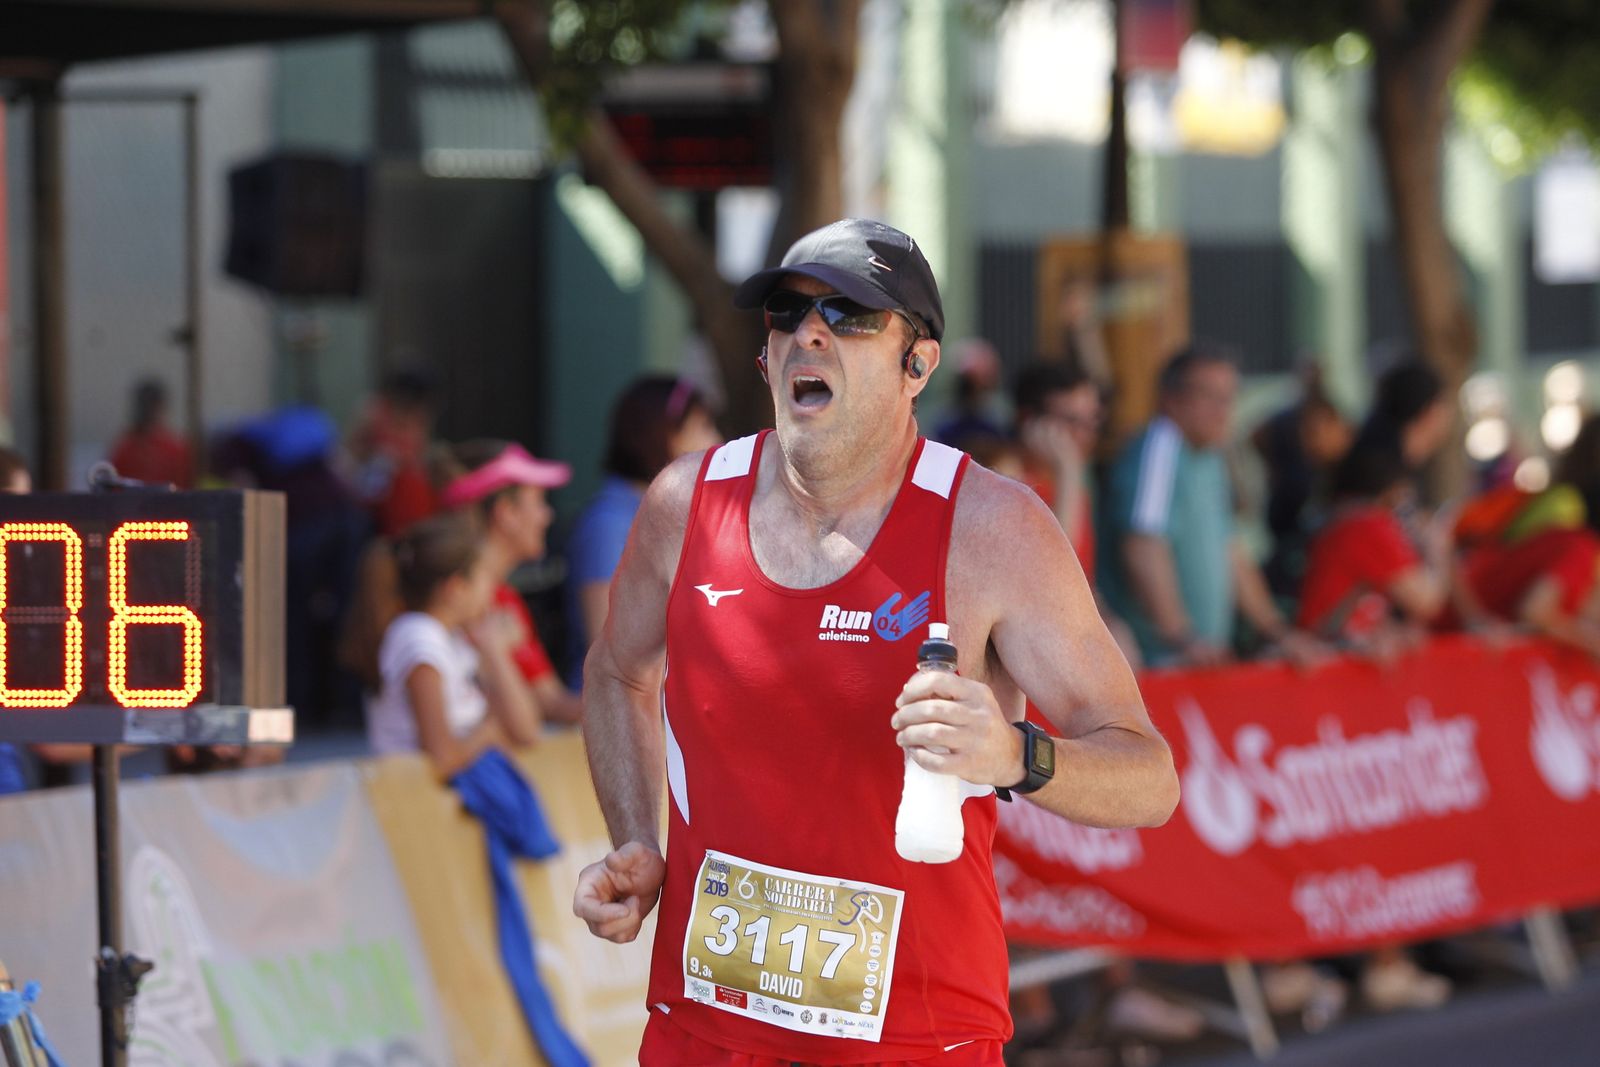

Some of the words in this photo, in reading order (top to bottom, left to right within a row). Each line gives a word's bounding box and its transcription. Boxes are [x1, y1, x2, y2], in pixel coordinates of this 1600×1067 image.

[0, 521, 202, 708] 06
[819, 604, 872, 631] Run
[877, 616, 902, 637] 04
[818, 630, 870, 643] atletismo
[703, 877, 730, 898] 2019
[765, 877, 836, 902] CARRERA
[764, 889, 834, 915] SOLIDARIA
[703, 904, 858, 981] 3117
[759, 970, 803, 999] DAVID
